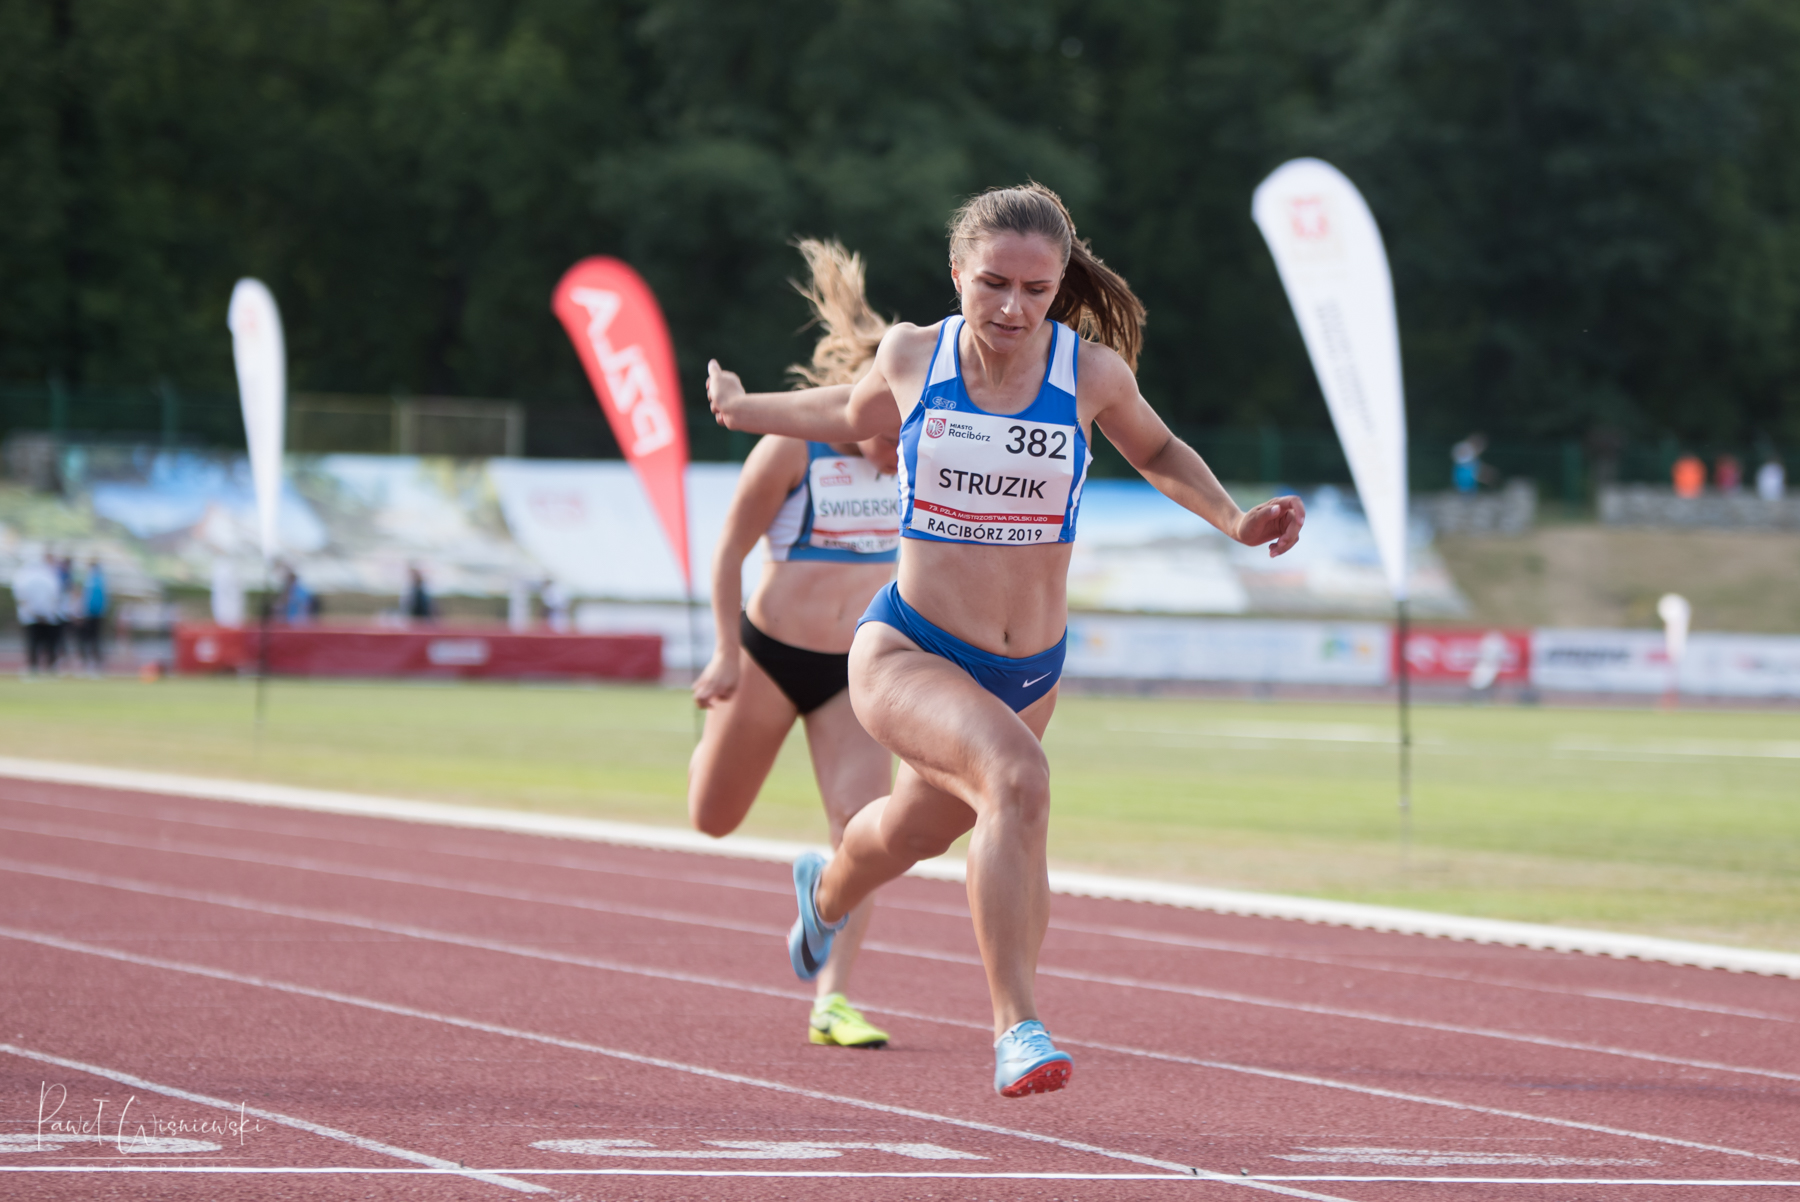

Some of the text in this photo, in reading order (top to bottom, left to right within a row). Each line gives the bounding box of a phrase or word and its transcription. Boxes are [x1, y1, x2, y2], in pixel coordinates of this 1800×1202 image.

[948, 429, 991, 442] Racibórz
[949, 423, 973, 431] MIASTO
[1005, 425, 1067, 460] 382
[938, 468, 1047, 499] STRUZIK
[940, 507, 957, 517] PZLA
[927, 518, 1043, 541] RACIBÓRZ 2019
